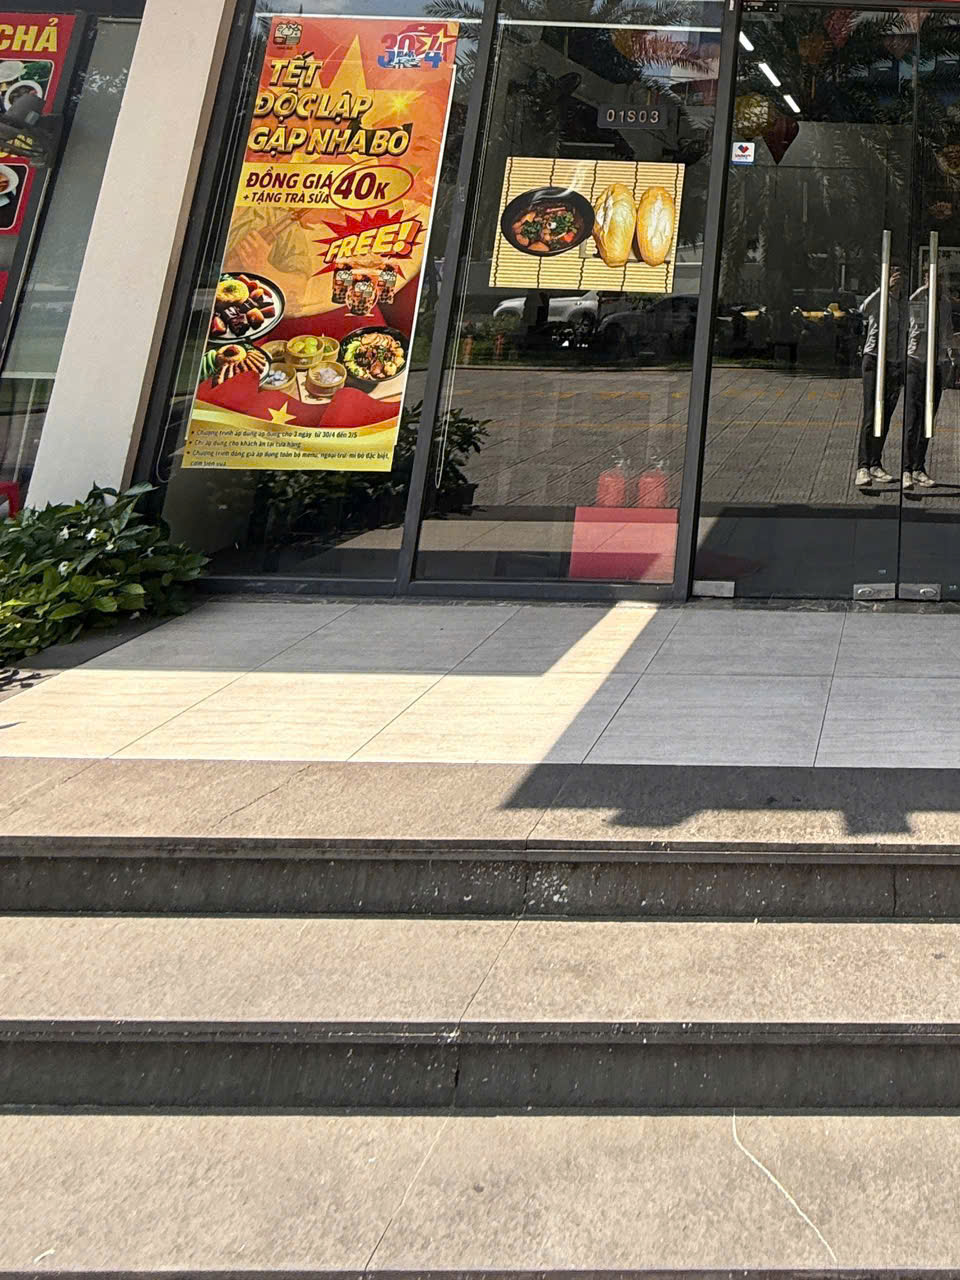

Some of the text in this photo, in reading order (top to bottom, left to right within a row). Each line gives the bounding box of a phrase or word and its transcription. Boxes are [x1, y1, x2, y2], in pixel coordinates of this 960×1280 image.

[269, 52, 323, 87] TẾT
[253, 88, 374, 124] ĐỘC LẬP
[606, 108, 660, 124] 01S03
[247, 124, 308, 157] GẶP
[246, 166, 300, 189] ĐỒNG
[302, 170, 333, 189] GIÁ
[251, 190, 283, 205] TẶNG
[284, 191, 306, 203] TRÀ
[306, 190, 330, 204] SỮA
[324, 220, 416, 263] FREE!
